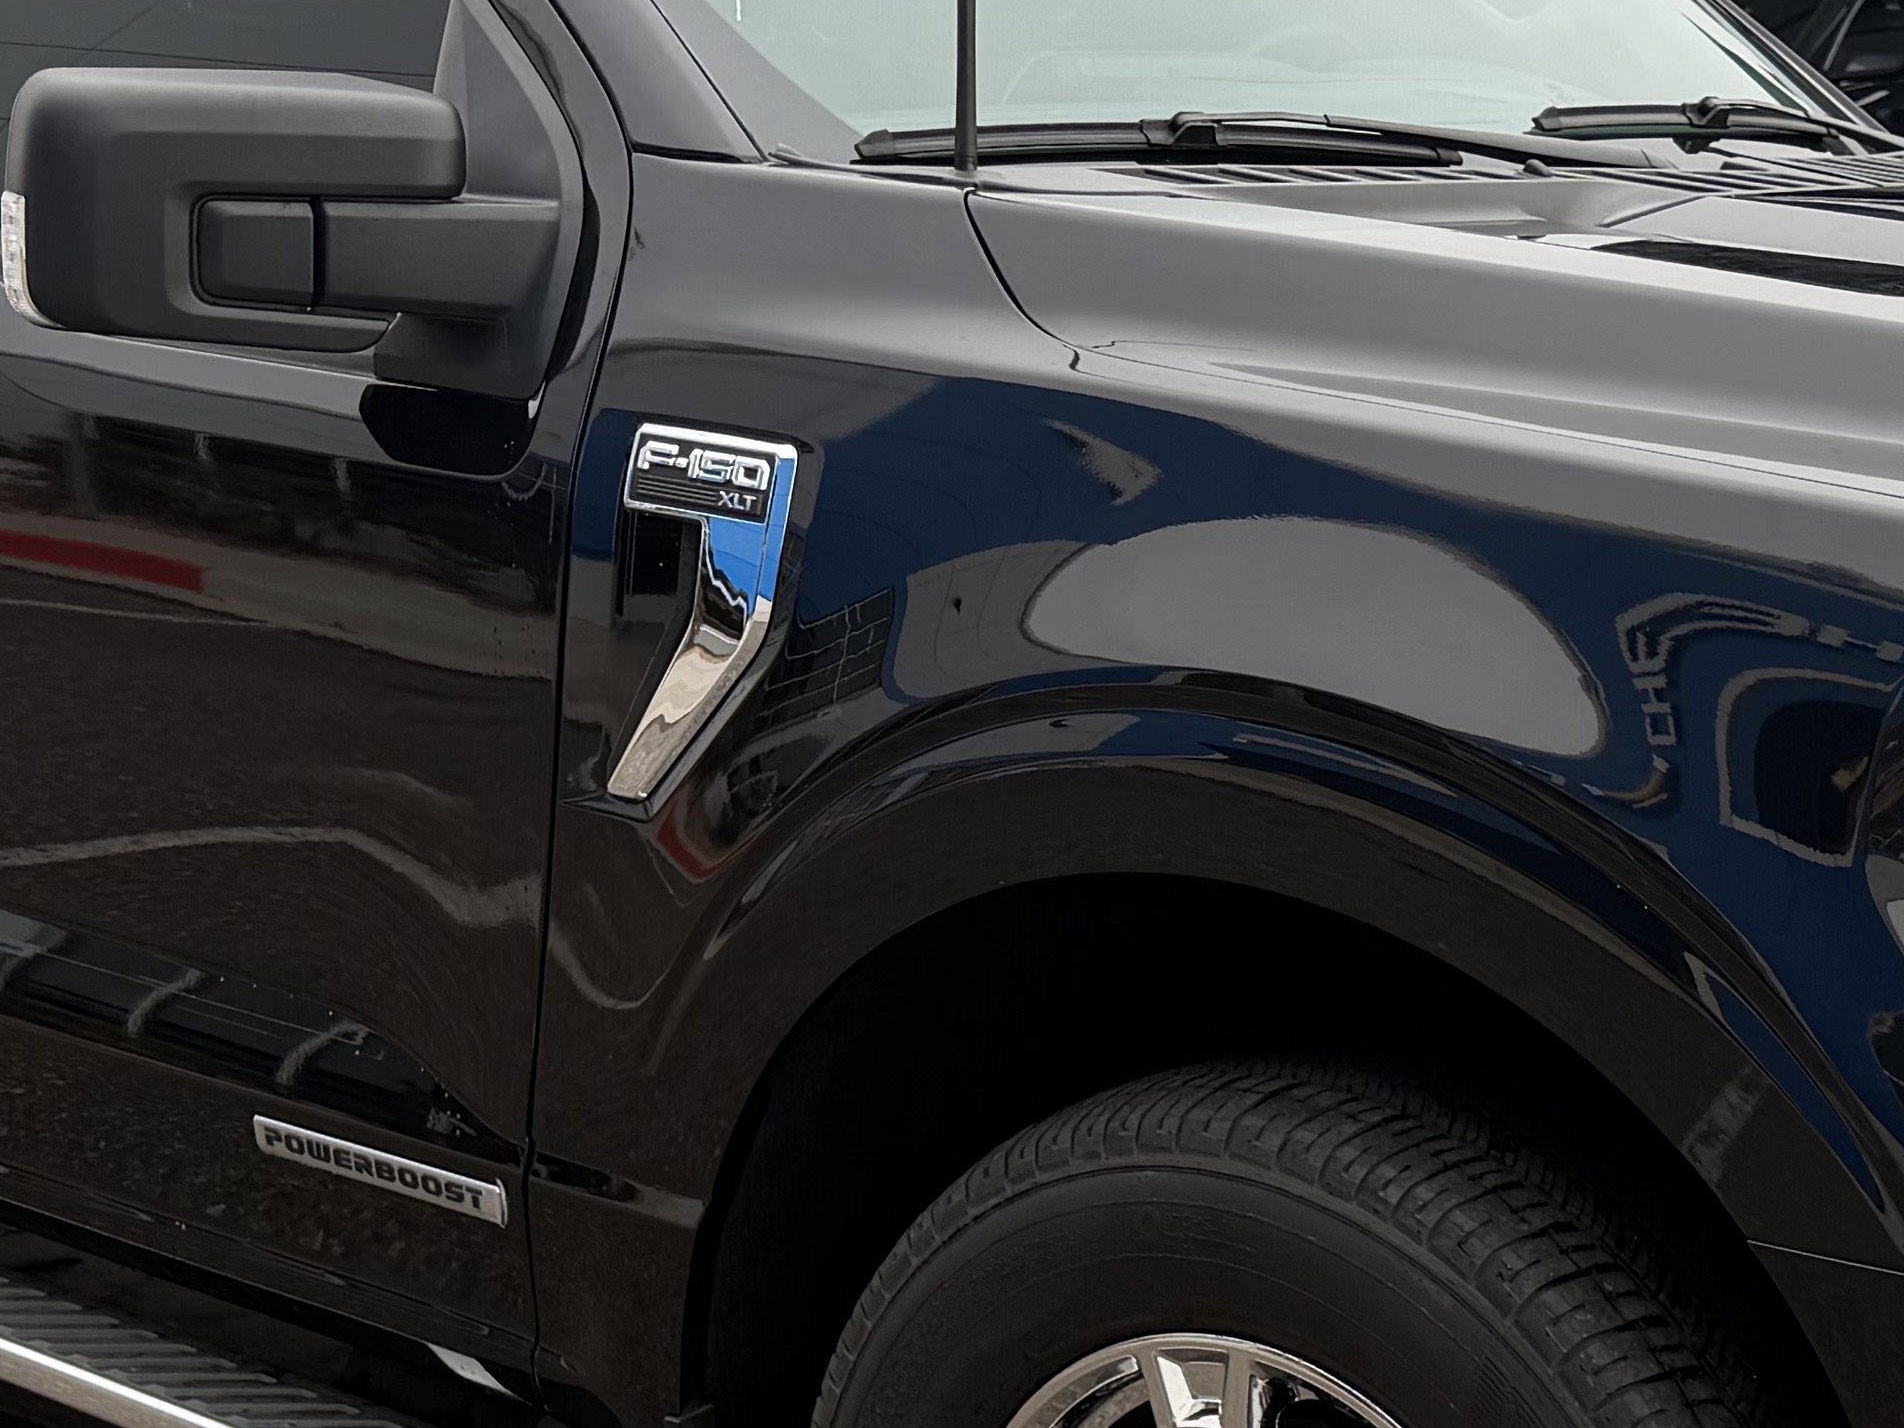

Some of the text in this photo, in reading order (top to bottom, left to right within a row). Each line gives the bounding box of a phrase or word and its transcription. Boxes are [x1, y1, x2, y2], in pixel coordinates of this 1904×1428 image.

[637, 440, 770, 491] F-150
[717, 490, 757, 511] XLT
[263, 1126, 483, 1210] POWERBOOST
